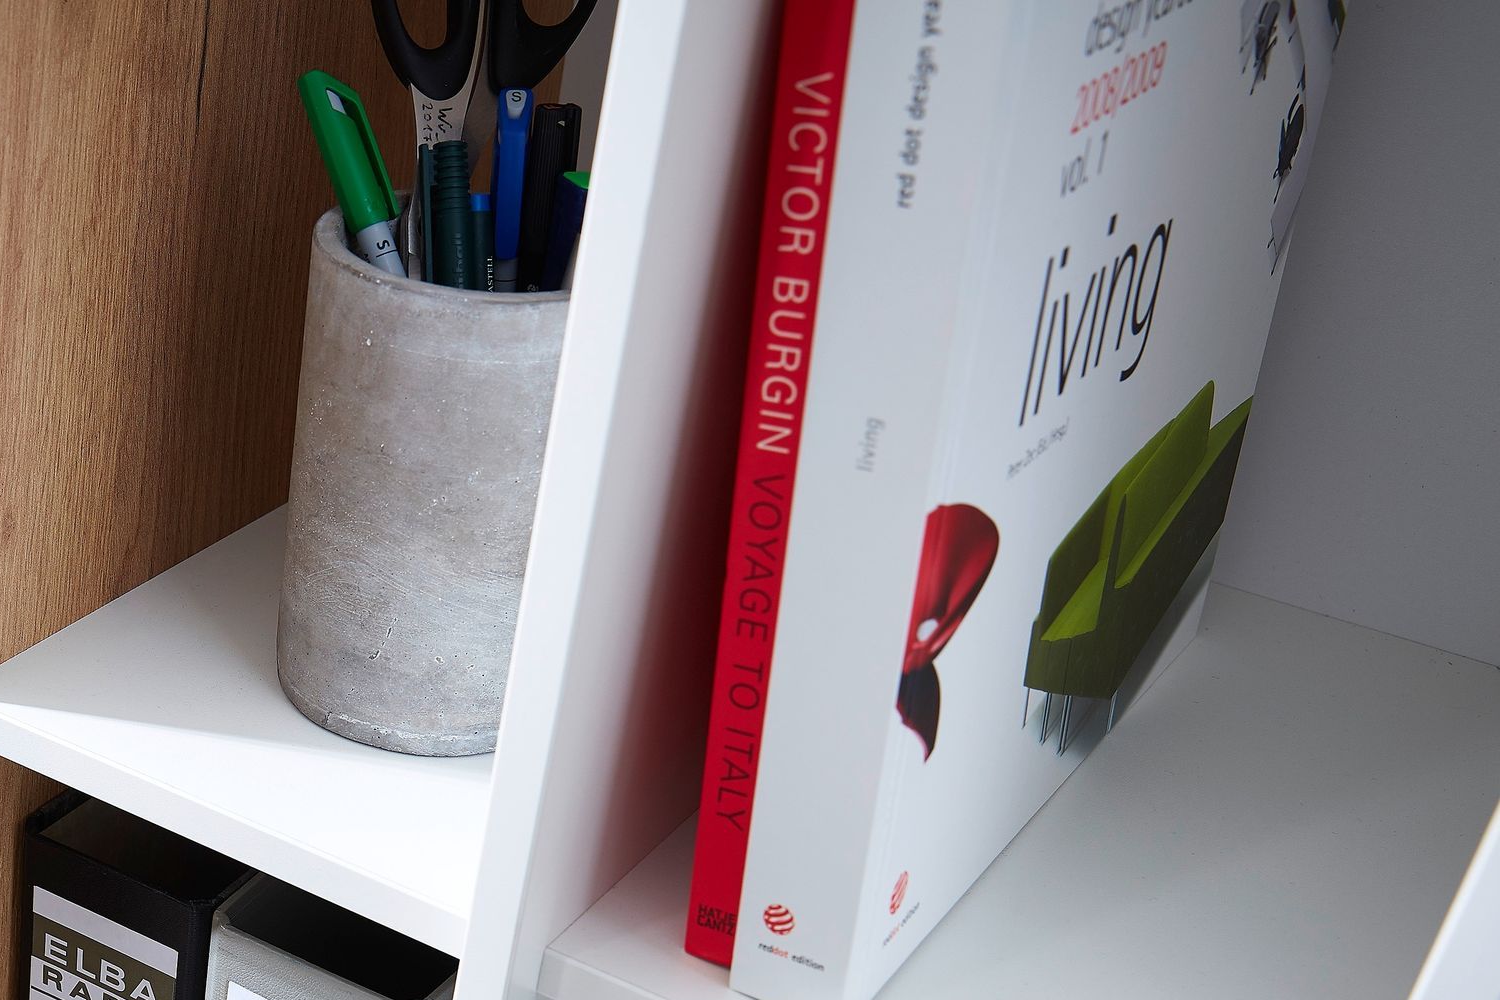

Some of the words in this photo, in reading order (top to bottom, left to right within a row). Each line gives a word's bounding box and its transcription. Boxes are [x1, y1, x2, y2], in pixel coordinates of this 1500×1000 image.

[907, 46, 938, 120] design
[1071, 41, 1168, 135] 2008/2009
[777, 71, 835, 256] VICTOR
[900, 128, 922, 166] dot
[896, 173, 917, 208] red
[486, 255, 494, 293] ASTELL
[1018, 213, 1174, 427] living
[755, 275, 810, 455] BURGIN
[735, 473, 786, 643] VOYAGE
[729, 659, 765, 710] TO
[715, 726, 756, 831] ITALY
[791, 955, 825, 971] edition
